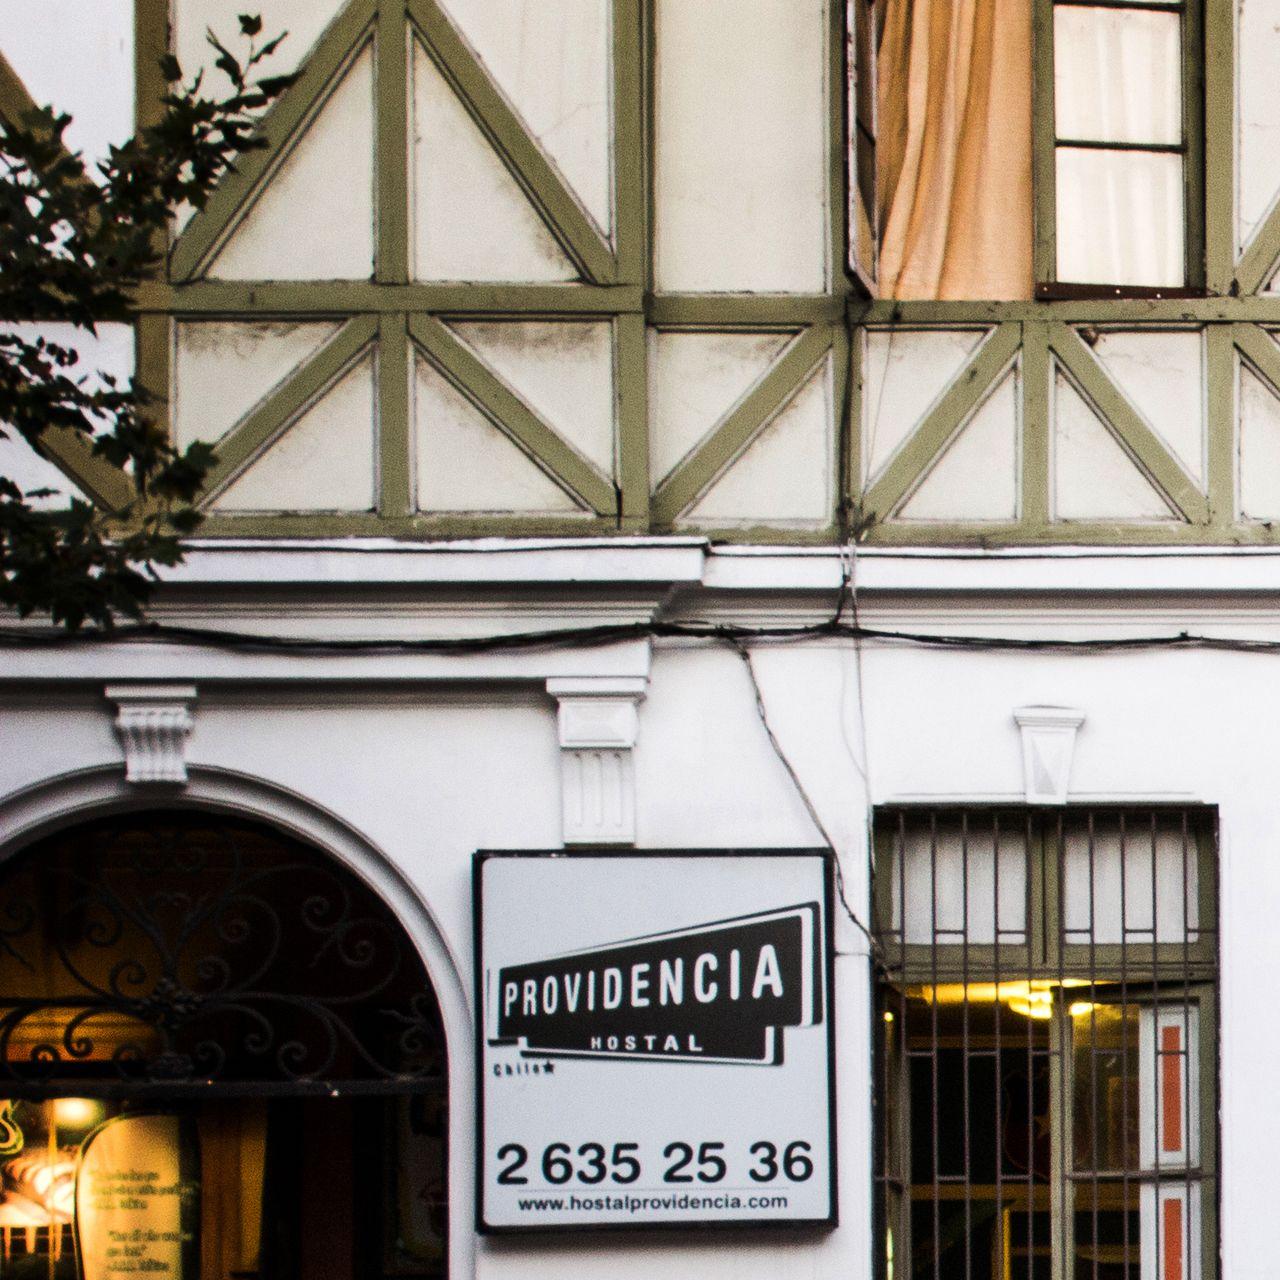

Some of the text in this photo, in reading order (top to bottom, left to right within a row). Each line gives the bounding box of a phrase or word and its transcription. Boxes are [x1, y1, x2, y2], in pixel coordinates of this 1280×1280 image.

[504, 943, 784, 1017] PROVIDENCIA
[590, 1034, 703, 1052] HOSTAL
[493, 1063, 540, 1077] Chile
[497, 1140, 814, 1185] 2 635 25 36
[518, 1193, 788, 1213] www.hostalprovidencia.com
